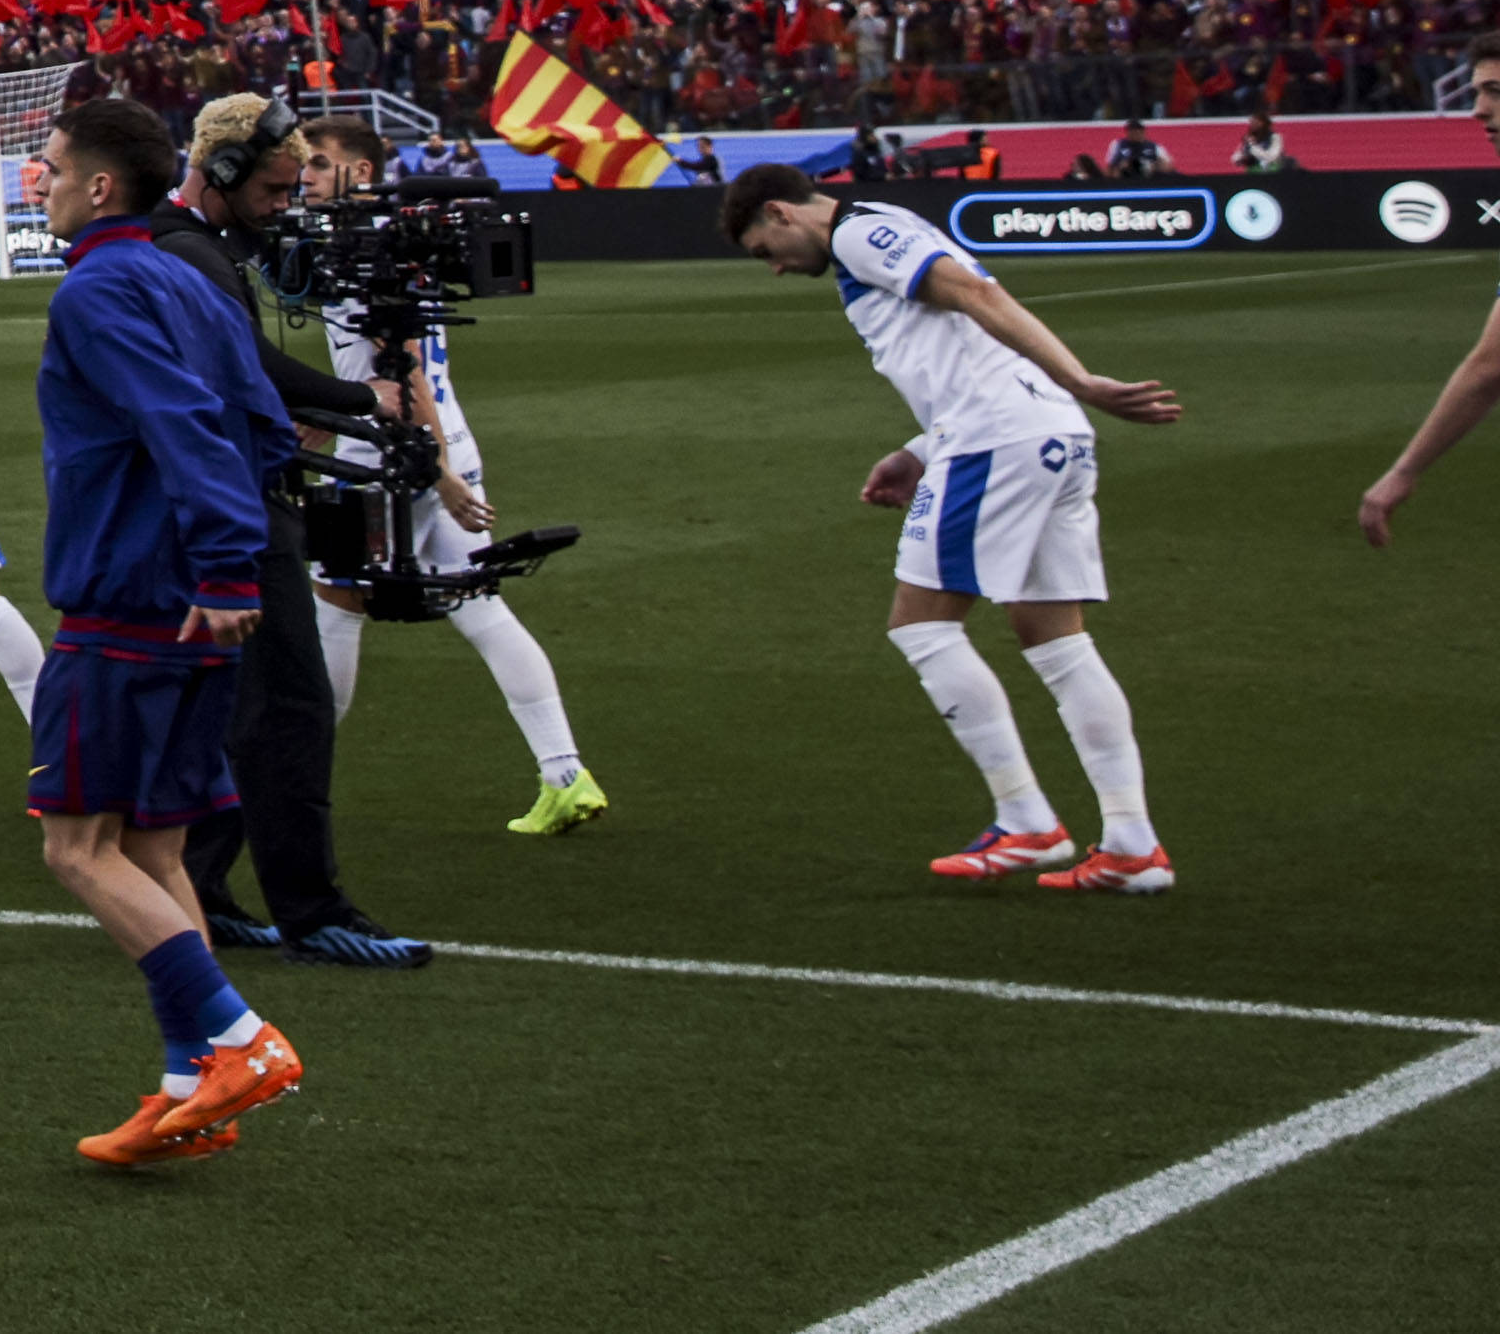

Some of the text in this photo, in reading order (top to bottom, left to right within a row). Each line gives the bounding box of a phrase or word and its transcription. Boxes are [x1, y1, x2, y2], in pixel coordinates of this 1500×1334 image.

[993, 205, 1192, 237] play the Barça
[7, 228, 54, 254] play
